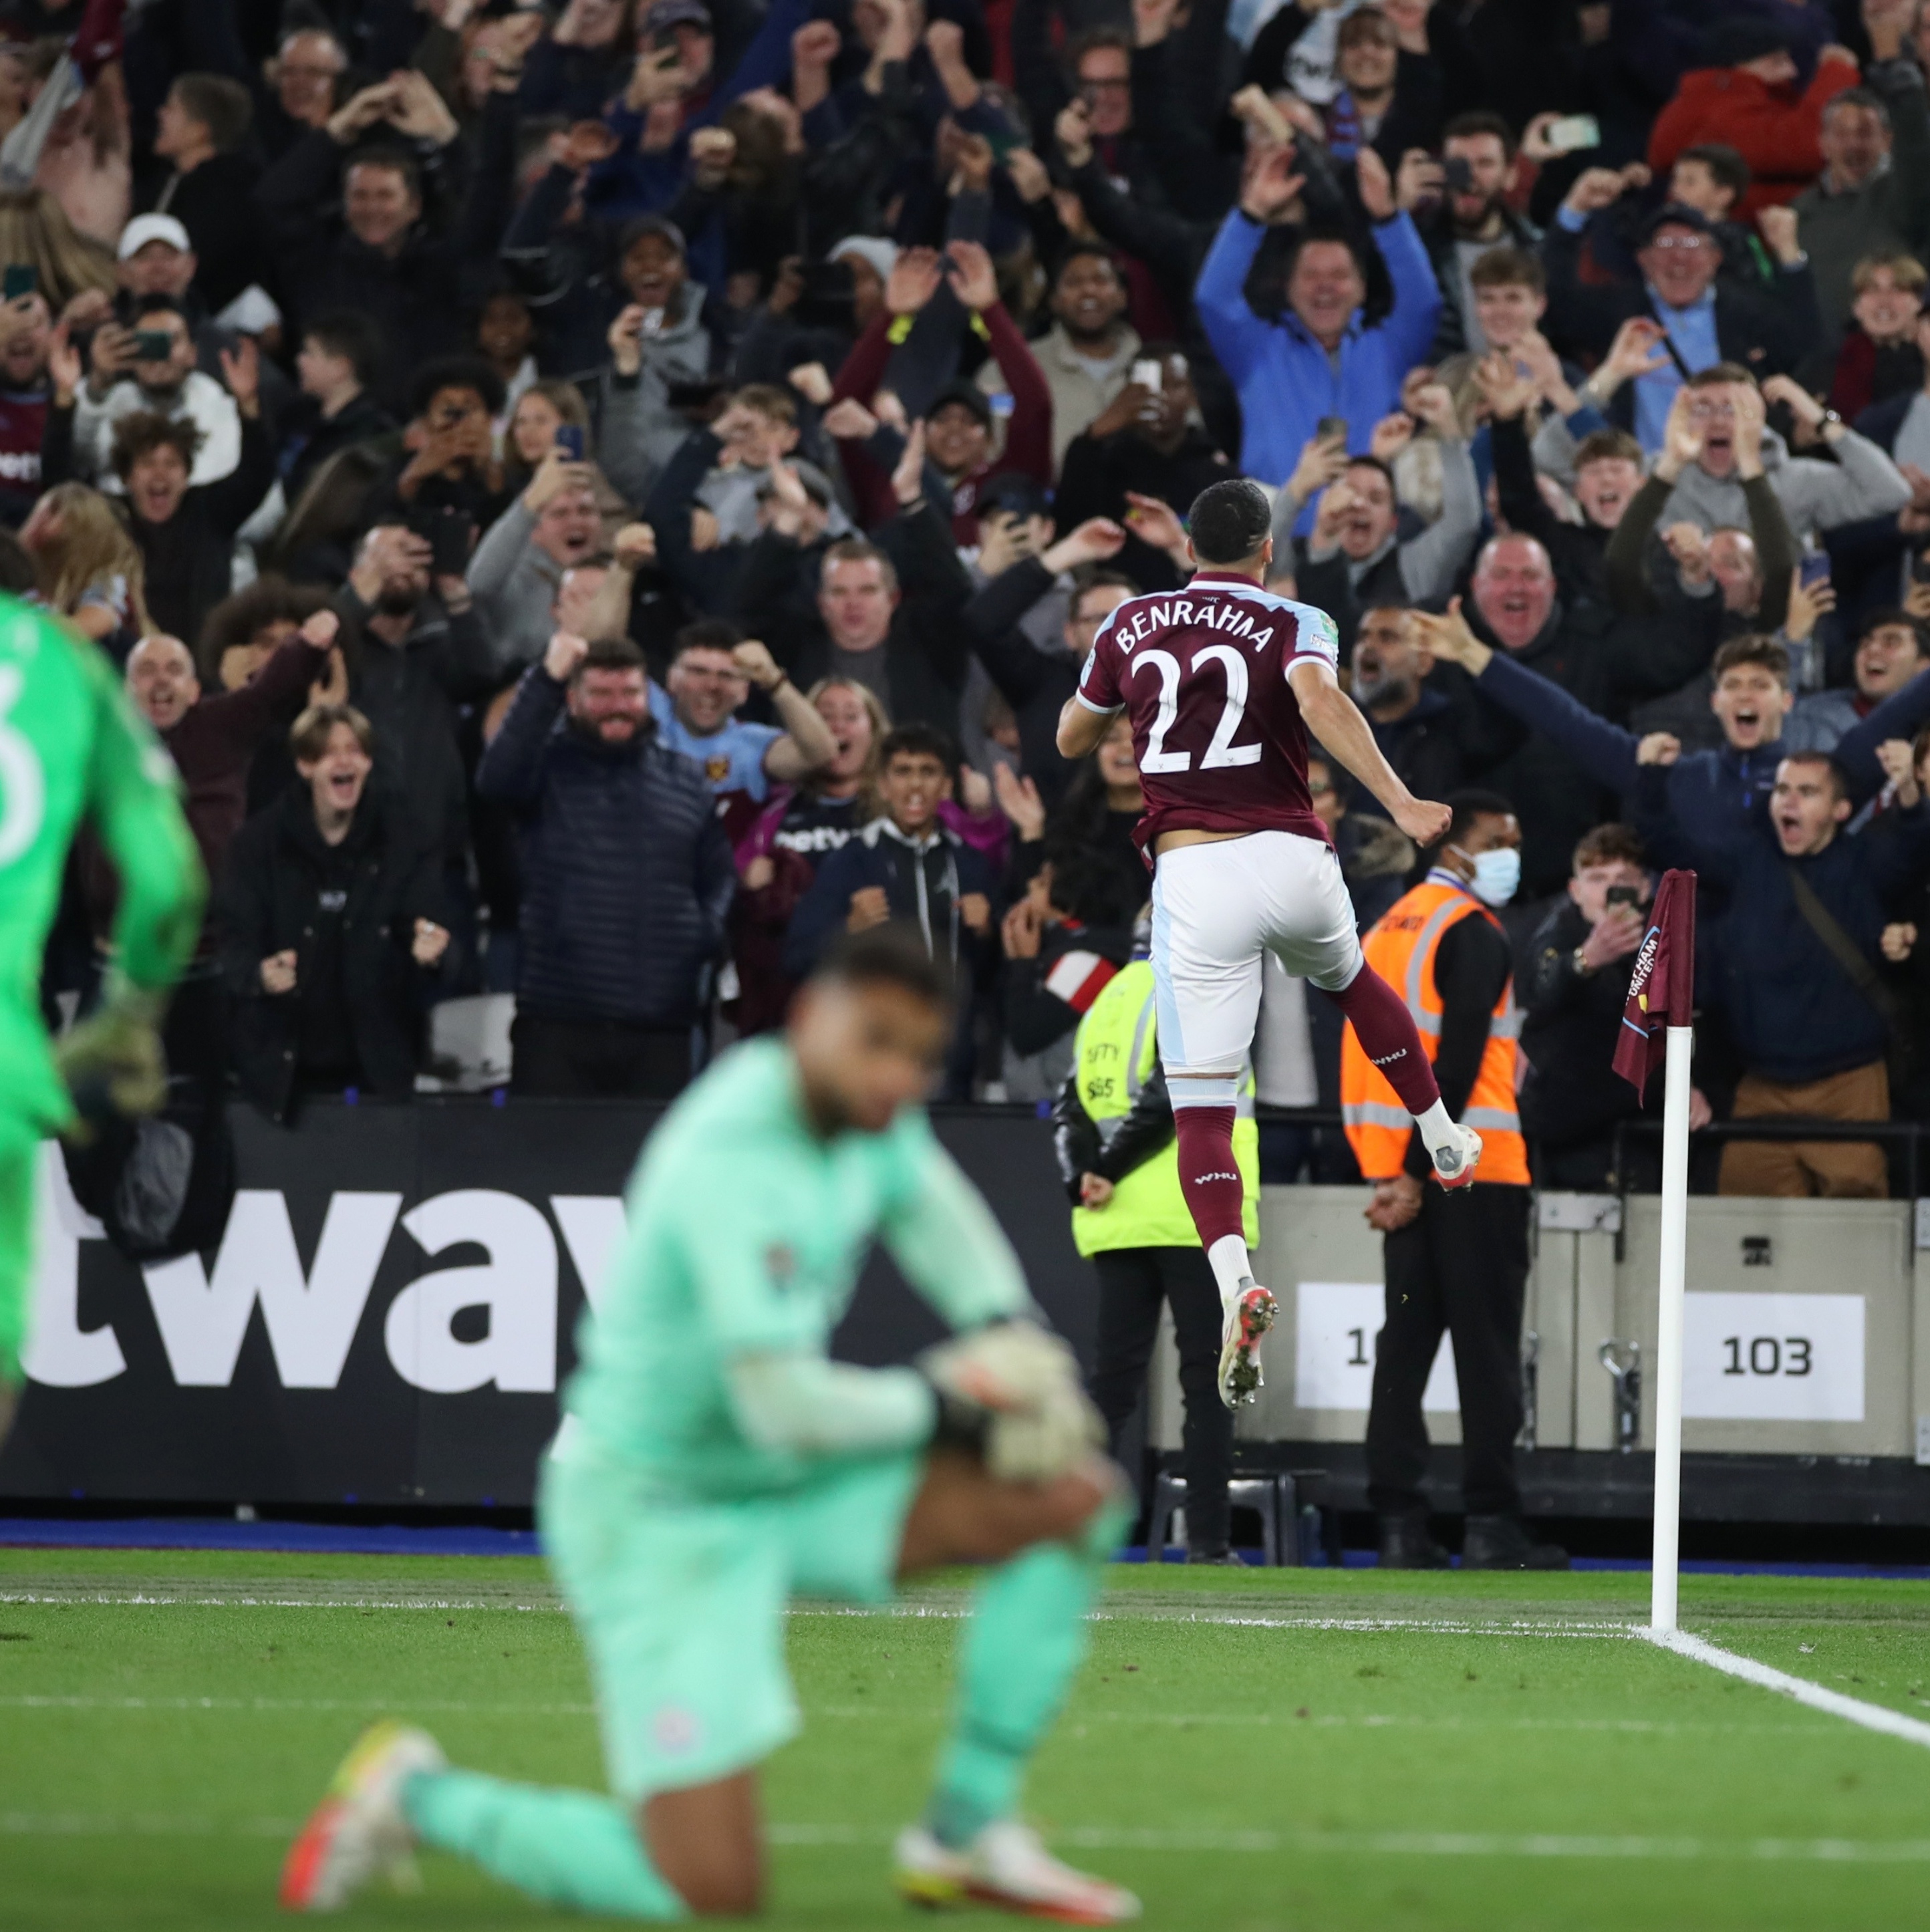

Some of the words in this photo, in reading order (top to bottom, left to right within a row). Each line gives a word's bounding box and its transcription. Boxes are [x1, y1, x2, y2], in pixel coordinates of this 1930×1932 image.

[1115, 601, 1274, 655] BENRAHMA
[1131, 644, 1262, 774] 22
[1635, 939, 1658, 970] HAM
[1371, 1048, 1407, 1065] WHU
[1194, 1172, 1237, 1184] WHU
[1723, 1336, 1812, 1375] 103
